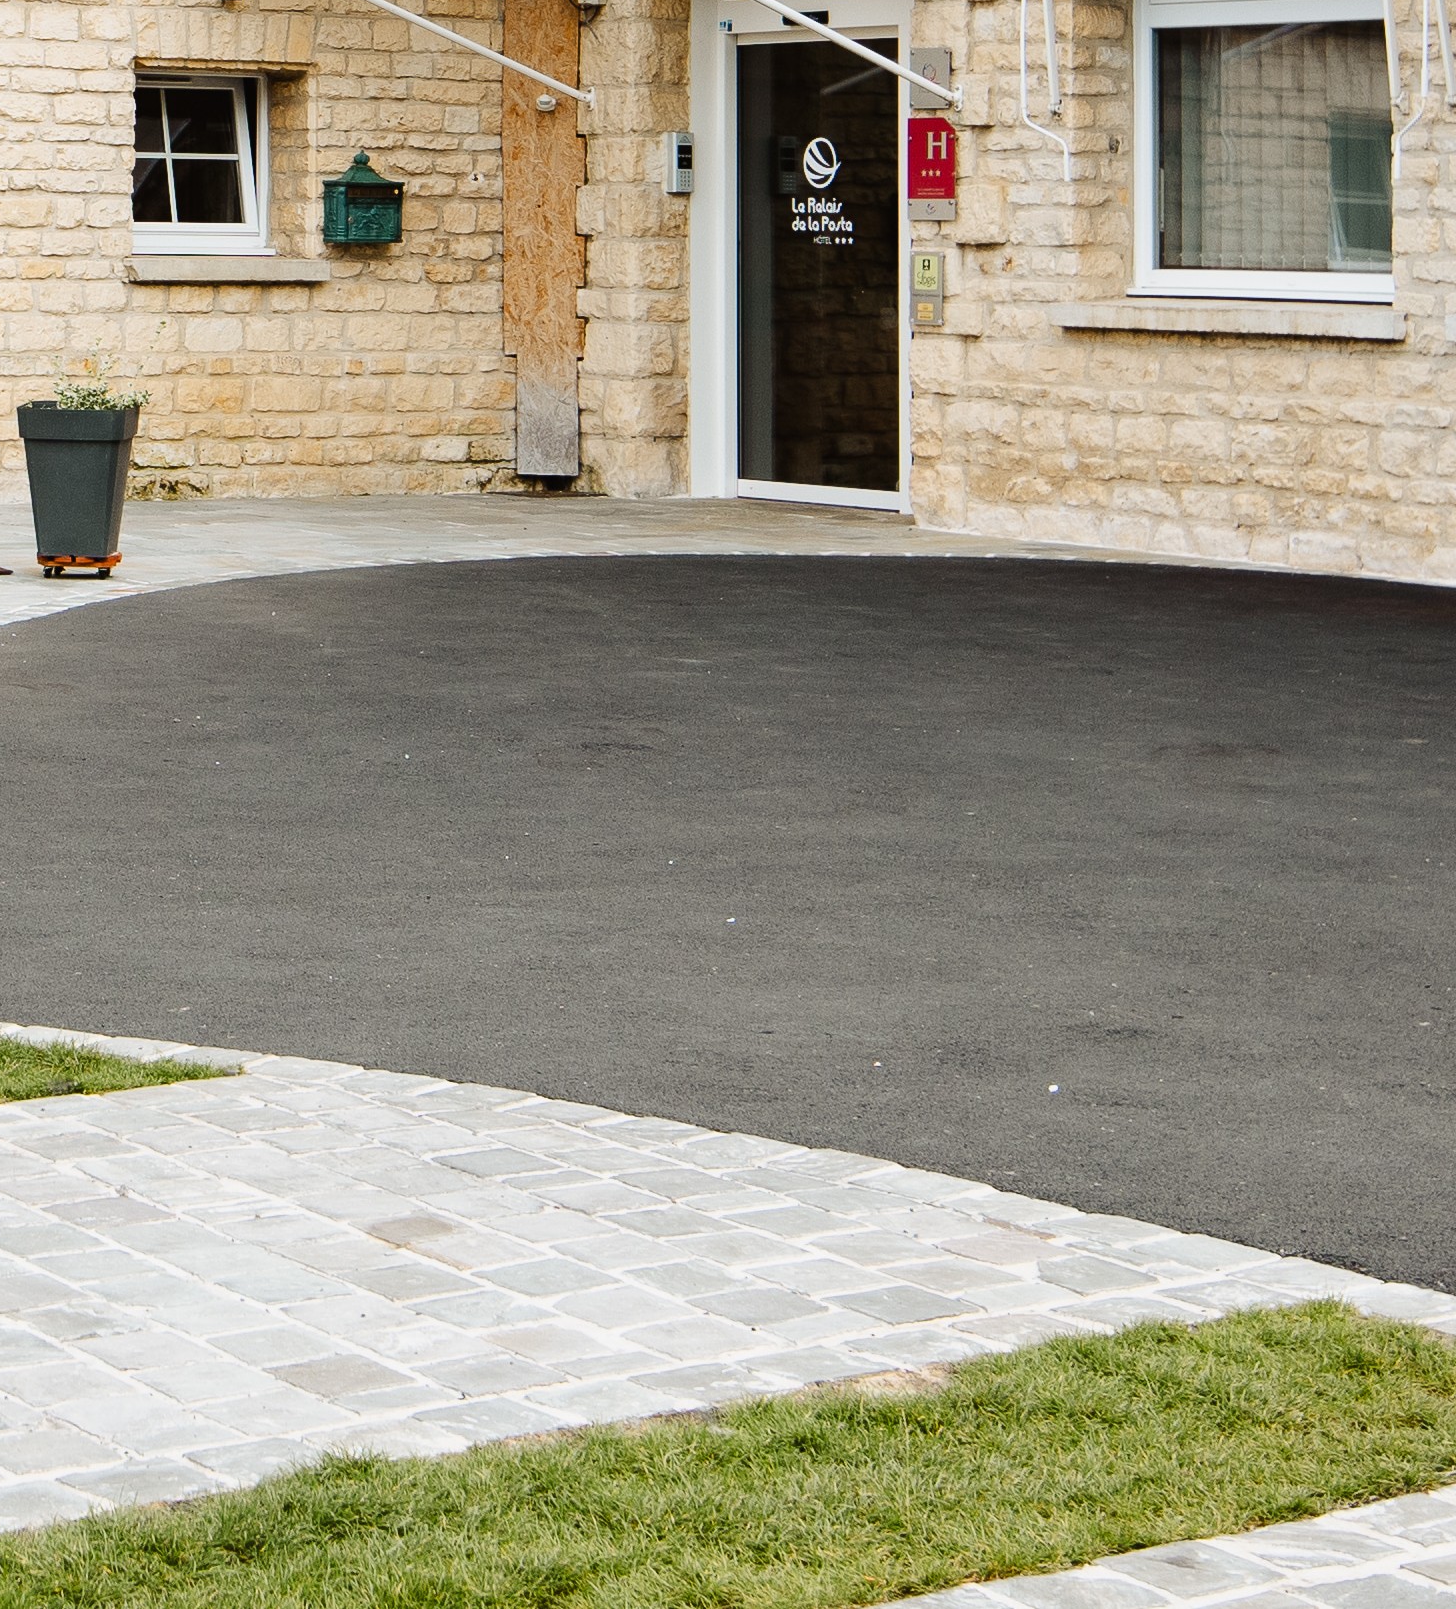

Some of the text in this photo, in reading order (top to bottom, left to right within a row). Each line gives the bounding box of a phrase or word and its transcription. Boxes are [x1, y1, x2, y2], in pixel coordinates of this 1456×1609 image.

[926, 131, 947, 160] H
[791, 197, 843, 214] Le Relais
[791, 215, 853, 232] de la Poste
